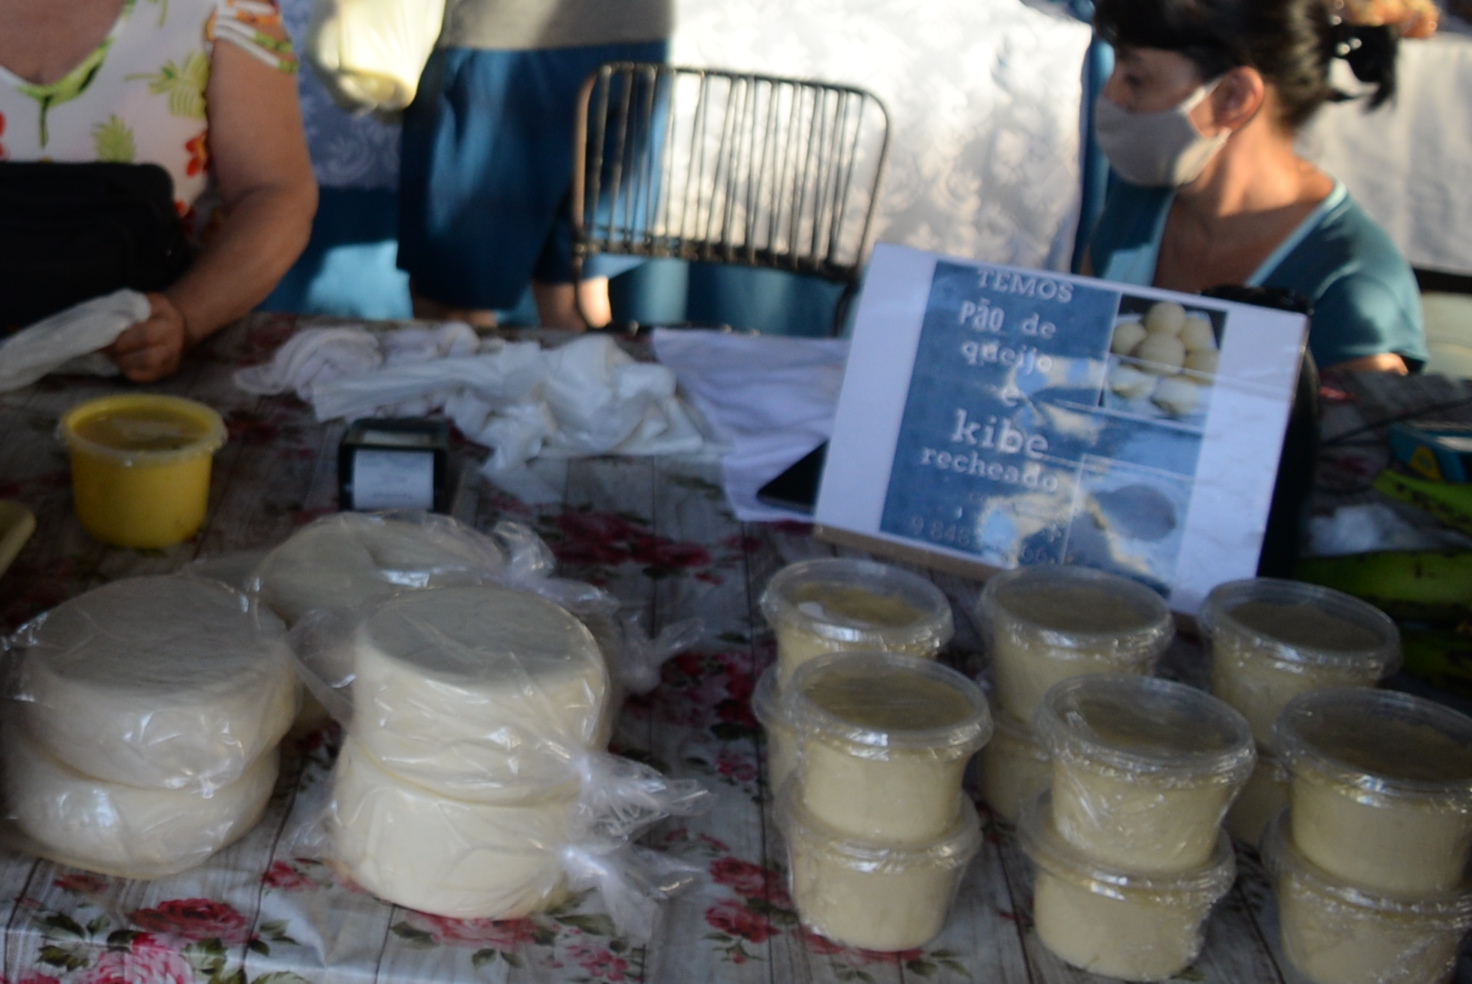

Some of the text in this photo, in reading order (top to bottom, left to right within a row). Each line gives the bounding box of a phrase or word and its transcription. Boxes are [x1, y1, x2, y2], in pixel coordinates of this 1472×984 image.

[976, 267, 1075, 304] TEMOS
[1022, 312, 1058, 339] de
[961, 338, 1054, 376] queijo
[951, 409, 1050, 458] kibe
[919, 444, 1059, 493] recheado
